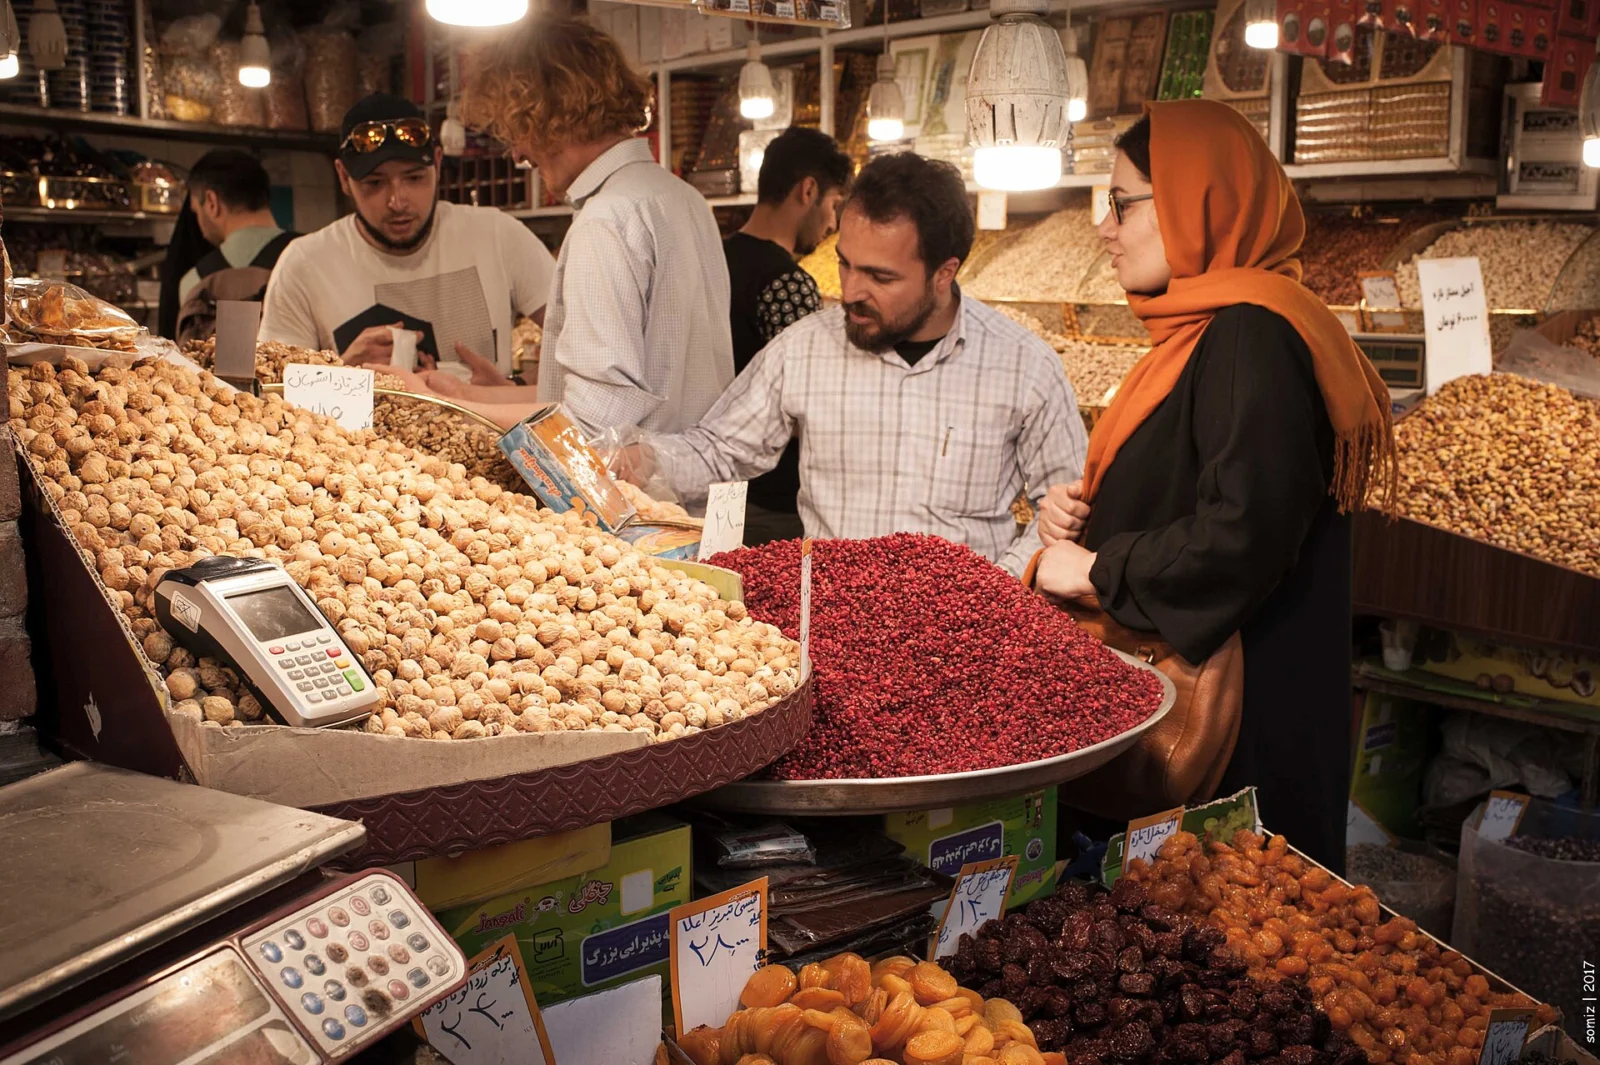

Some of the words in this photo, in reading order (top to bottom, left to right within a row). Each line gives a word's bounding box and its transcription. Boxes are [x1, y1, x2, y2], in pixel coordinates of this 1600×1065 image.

[945, 842, 978, 864] پذیرایی
[977, 836, 1000, 853] بزرگ
[568, 879, 614, 914] جنگلی
[585, 942, 618, 967] بزرگ
[618, 927, 664, 958] پذیرایی
